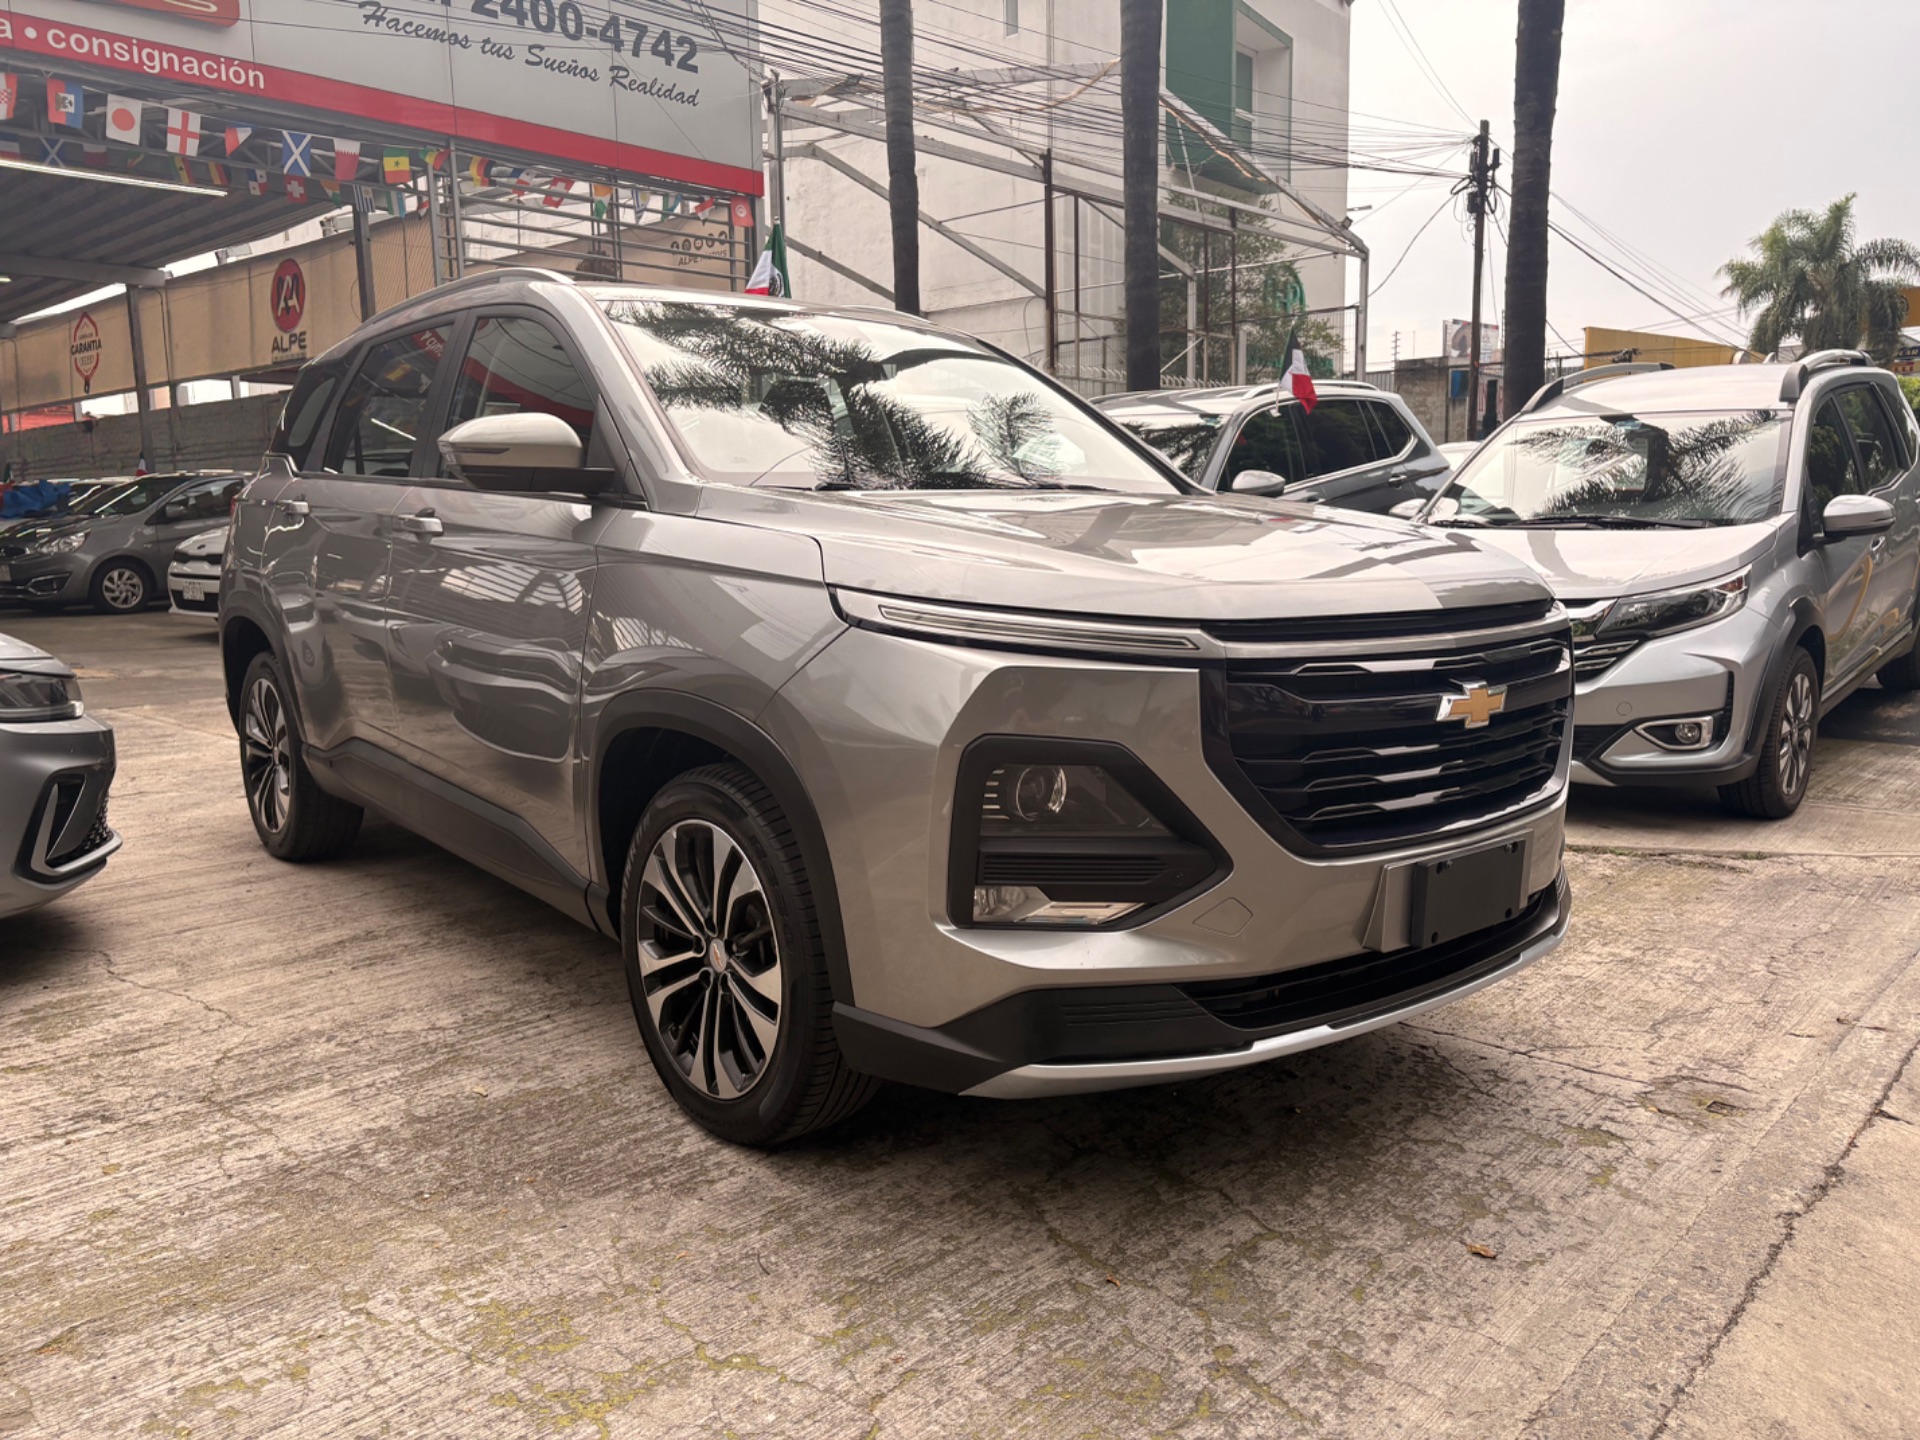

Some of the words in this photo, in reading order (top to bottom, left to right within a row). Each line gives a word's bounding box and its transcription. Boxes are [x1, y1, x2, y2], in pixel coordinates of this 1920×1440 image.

[46, 28, 265, 90] consignación
[358, 0, 472, 49] Hacemos
[480, 37, 515, 60] tus
[524, 44, 600, 82] Sueños
[609, 65, 699, 107] Realidad
[271, 331, 307, 354] ALPE
